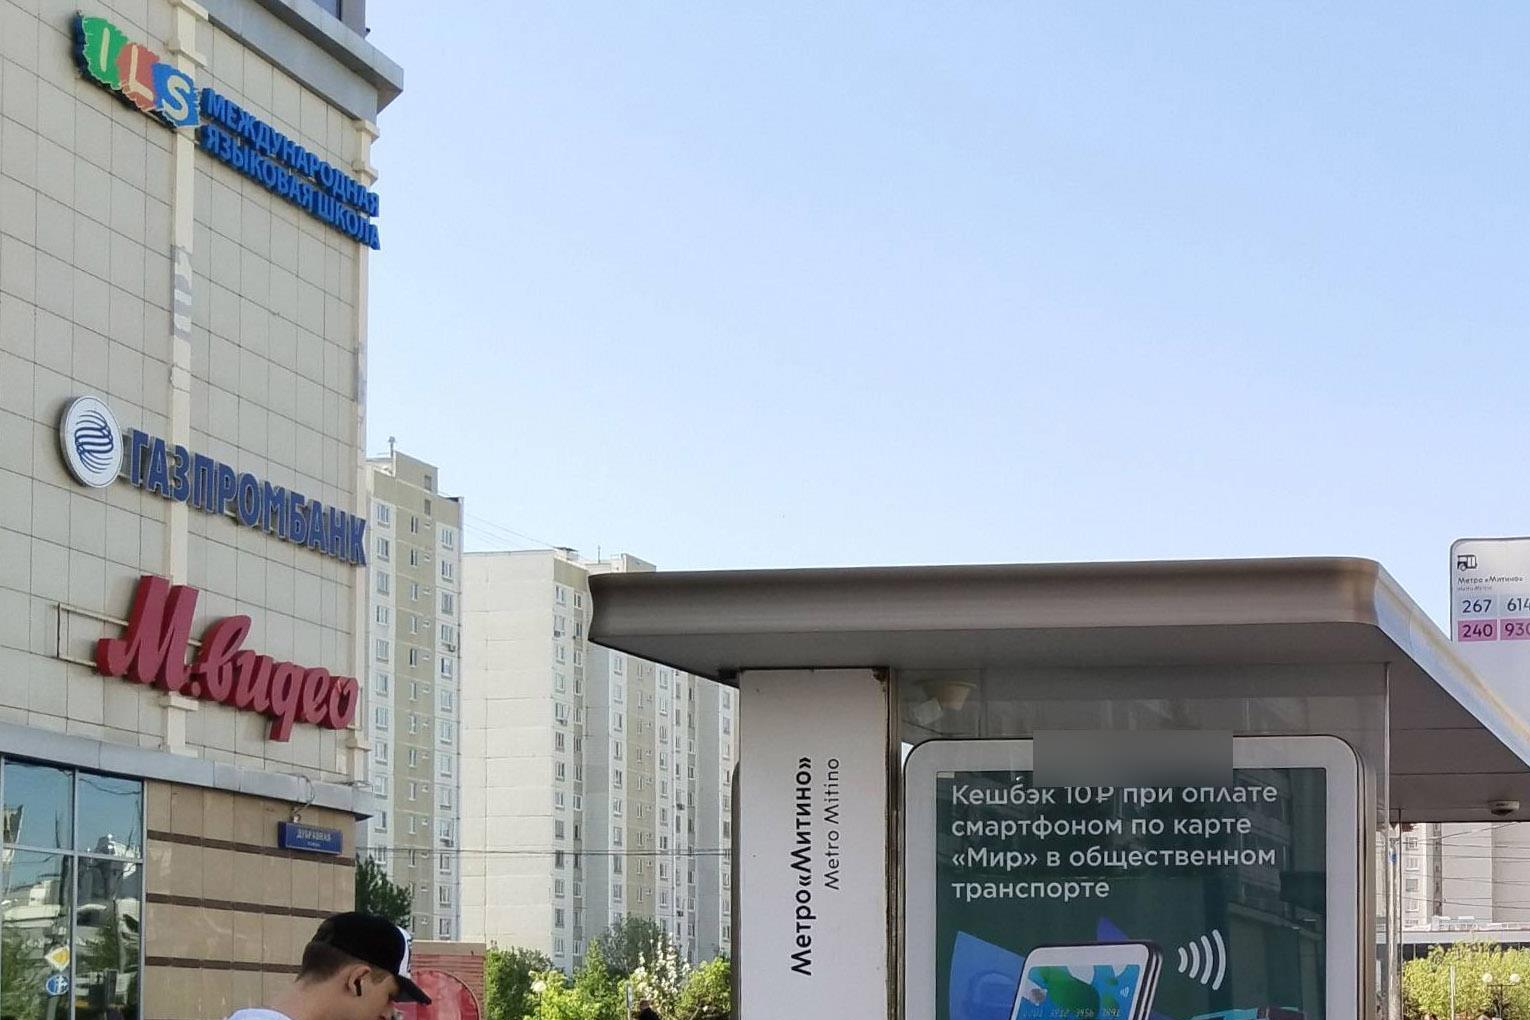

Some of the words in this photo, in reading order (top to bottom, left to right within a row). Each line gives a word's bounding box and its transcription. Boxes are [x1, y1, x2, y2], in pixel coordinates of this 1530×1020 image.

[101, 26, 192, 123] ILS
[201, 88, 380, 218] МЕЖДУНАРОДНАЯ
[204, 127, 313, 213] ЯЗЫКОВАЯ
[316, 193, 381, 251] ШКОЛА
[129, 428, 367, 568] ГАЗПРОМБАНК
[1462, 599, 1492, 614] 267
[1462, 624, 1493, 638] 240
[96, 575, 358, 742] М.видео
[823, 757, 840, 824] Mitino
[952, 783, 1056, 805] Кешбэк
[1123, 787, 1173, 808] при
[1182, 786, 1278, 803] оплате
[952, 814, 1122, 840] смартфоном
[1132, 818, 1165, 835] по
[1174, 818, 1252, 838] карте
[824, 830, 840, 890] Metro
[952, 848, 1038, 872] «Мир»
[1046, 852, 1061, 867] в
[1070, 847, 1276, 870] общественном
[952, 880, 1111, 903] транспорте
